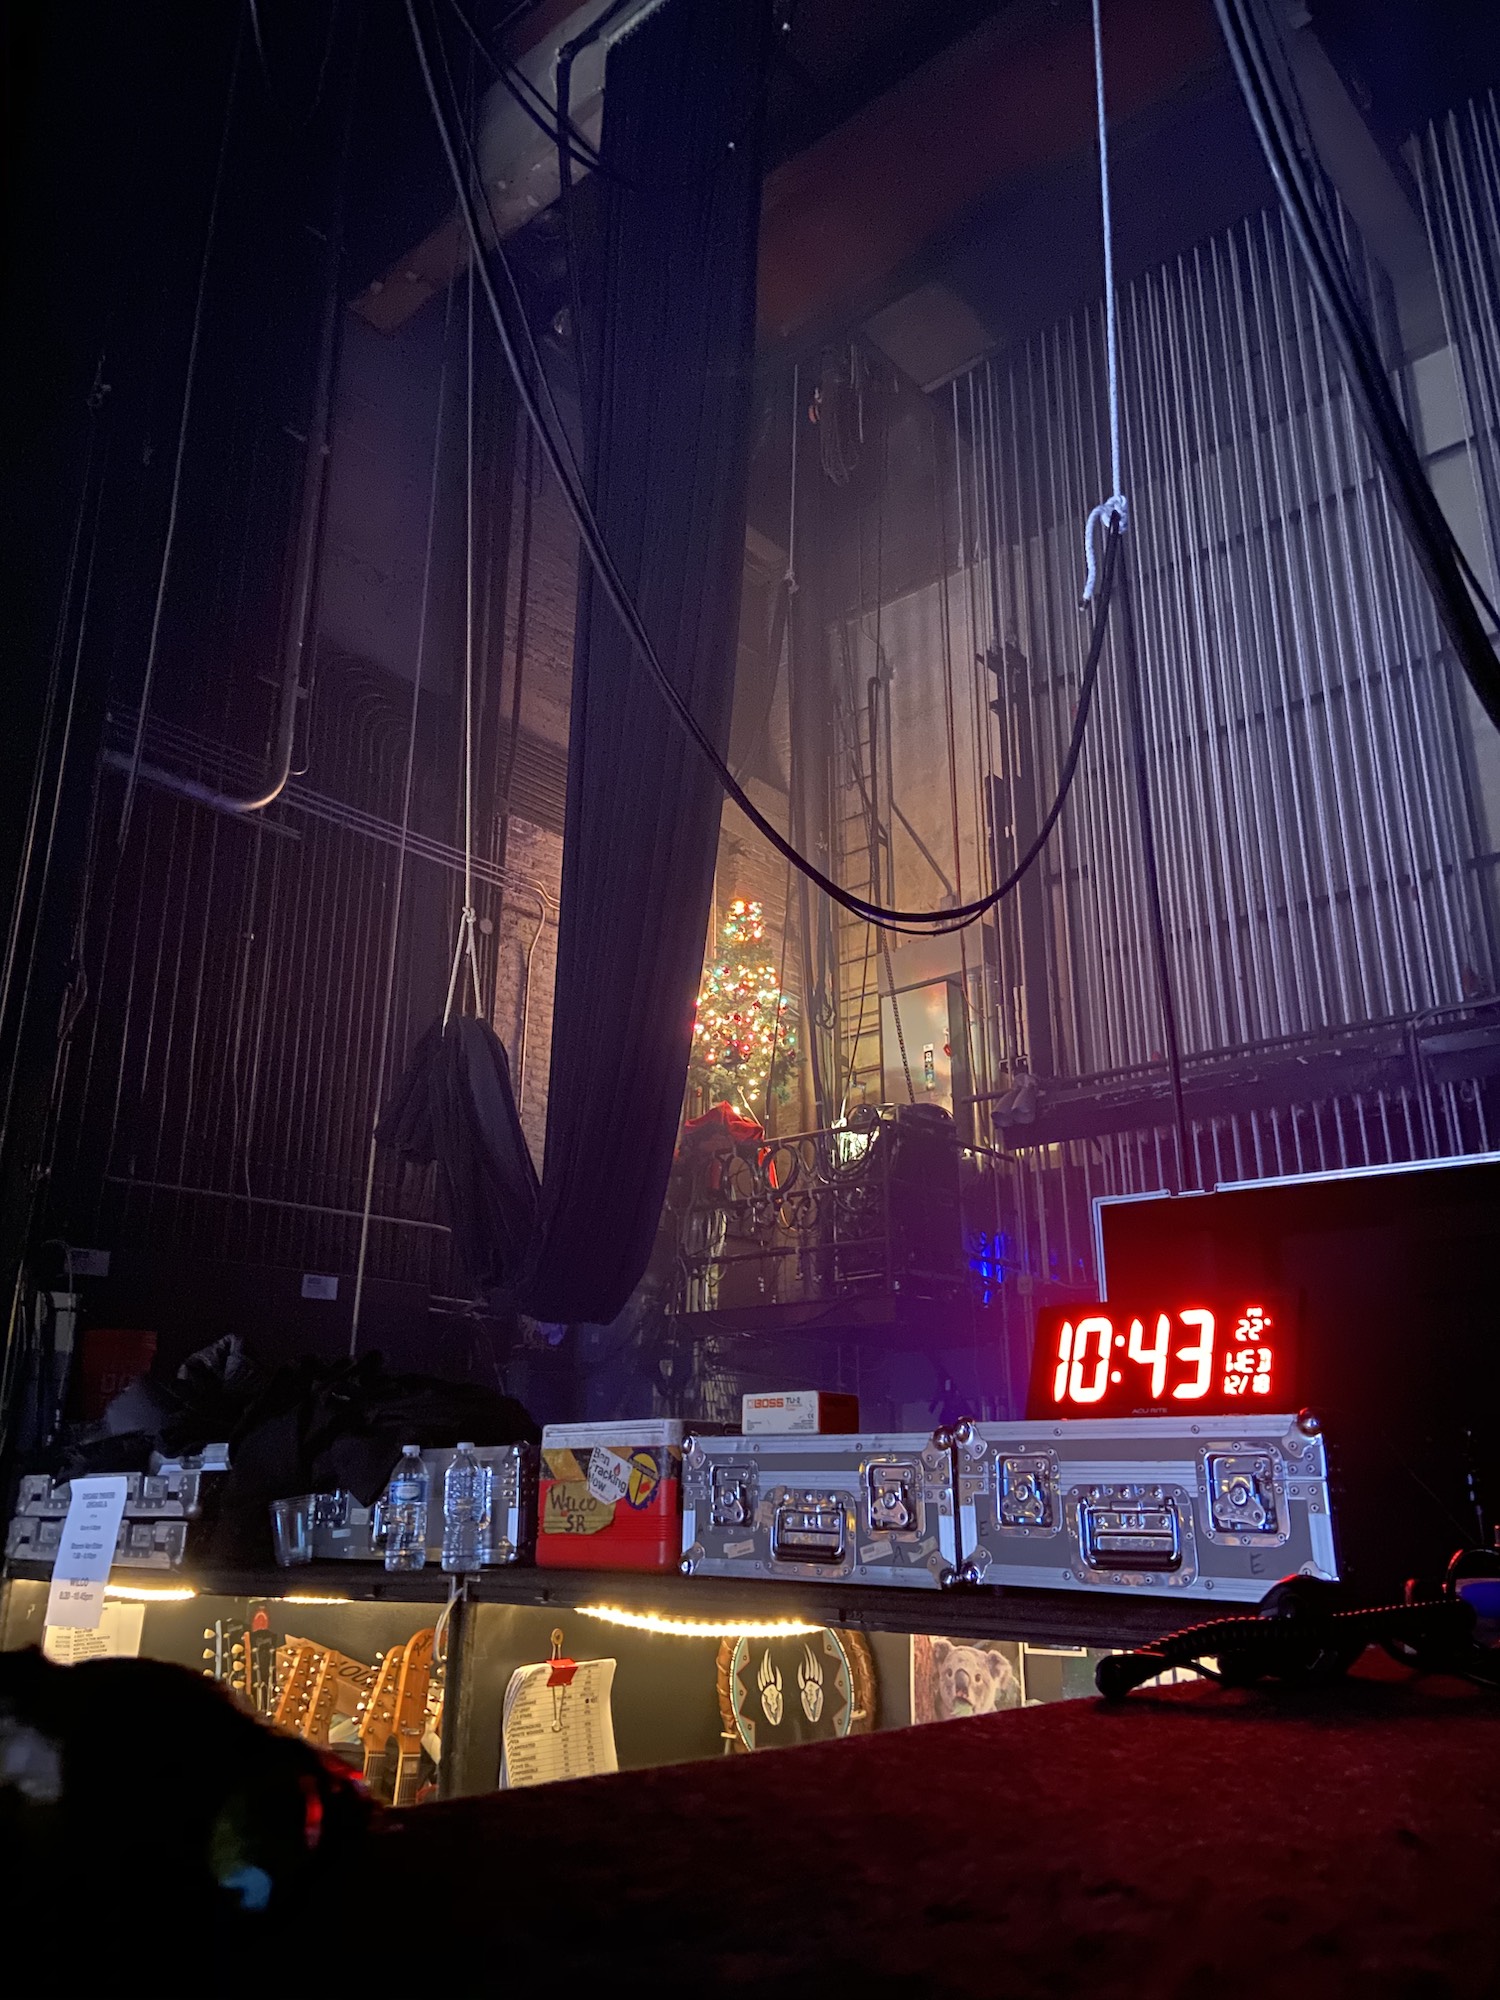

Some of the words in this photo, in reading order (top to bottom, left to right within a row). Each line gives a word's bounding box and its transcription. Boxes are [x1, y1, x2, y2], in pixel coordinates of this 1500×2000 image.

[1054, 1308, 1215, 1403] 10:43
[754, 1397, 784, 1409] BOSS
[593, 1446, 611, 1467] Ban
[564, 1513, 586, 1533] SR
[1249, 1551, 1265, 1576] E
